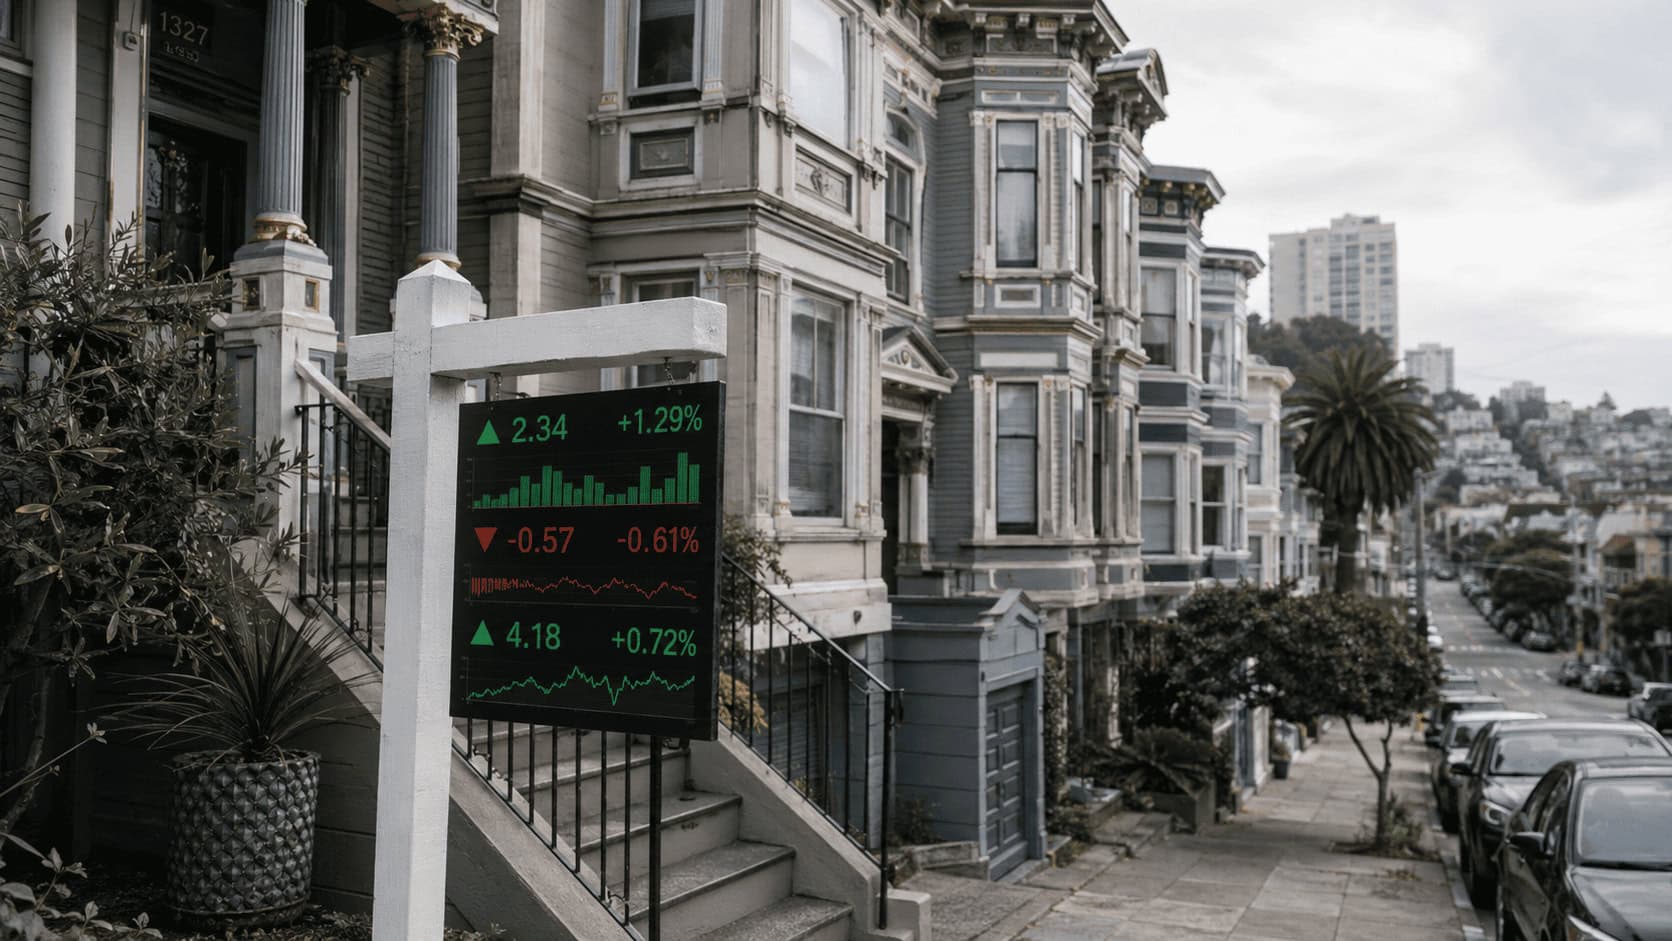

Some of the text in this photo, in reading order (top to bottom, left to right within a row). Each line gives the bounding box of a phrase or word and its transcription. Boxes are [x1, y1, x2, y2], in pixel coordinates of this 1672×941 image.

[160, 11, 208, 45] 1327
[511, 404, 703, 443] 2.34 +1.29%
[508, 526, 700, 553] -0.57 -0.61%
[506, 621, 697, 656] 4.18 +0.72%
